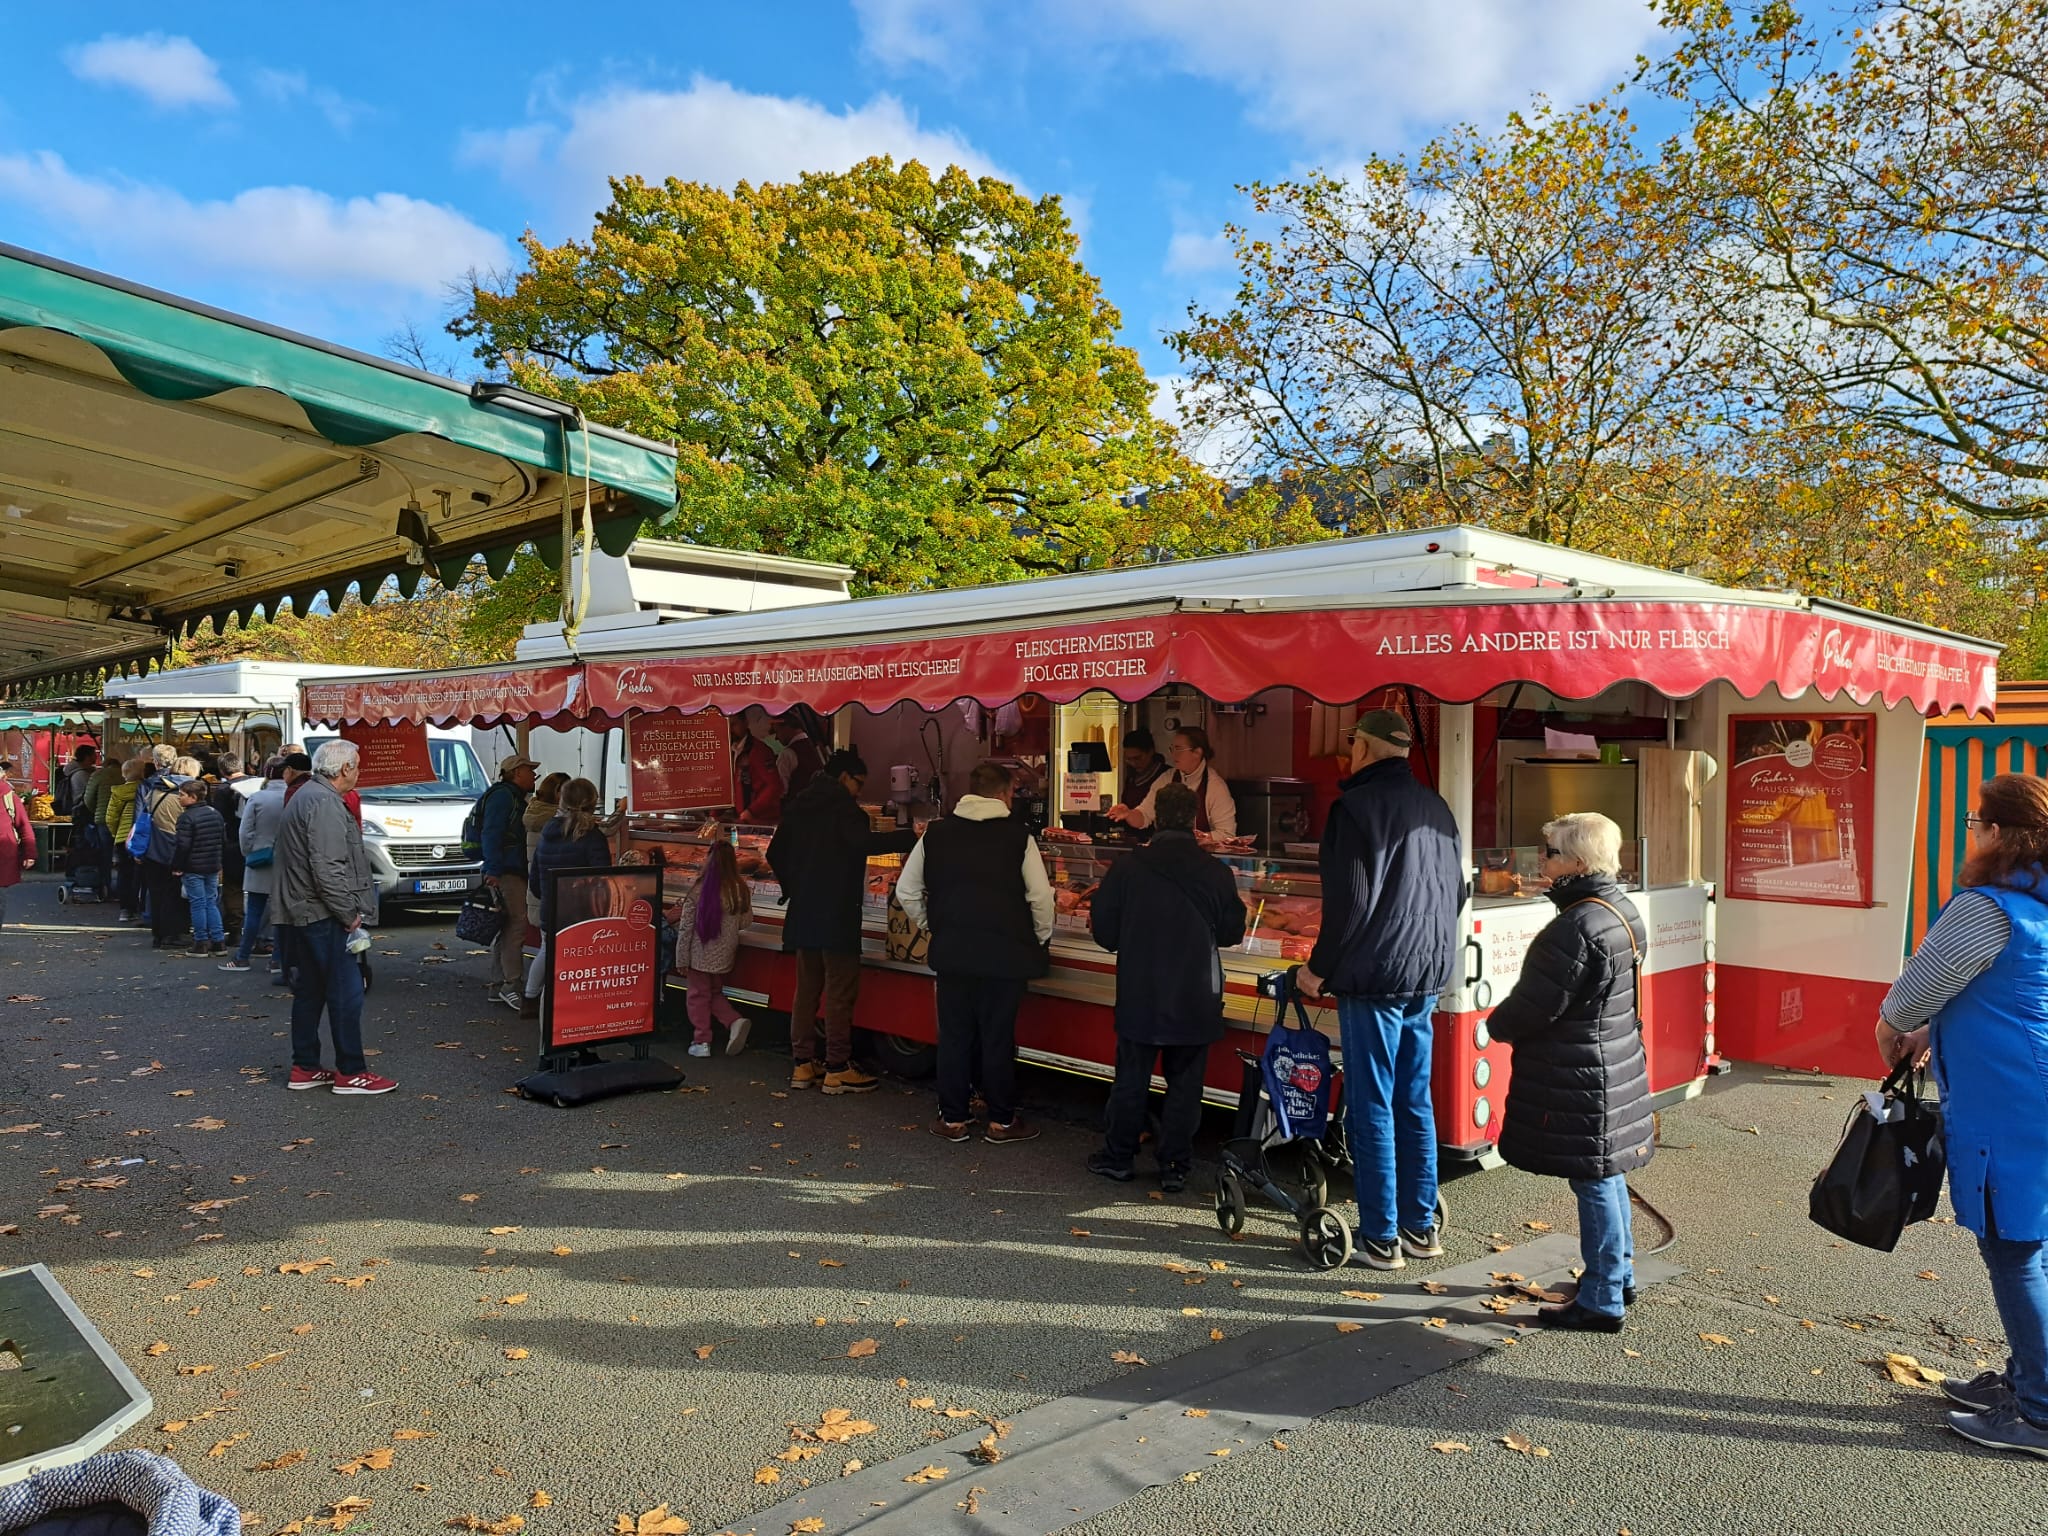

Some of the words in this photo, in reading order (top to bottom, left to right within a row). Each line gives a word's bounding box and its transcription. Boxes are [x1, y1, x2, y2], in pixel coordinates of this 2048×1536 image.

[1015, 630, 1155, 659] FLEISCHERMEISTER
[1375, 633, 1453, 655] ALLES
[1460, 631, 1561, 653] ANDERE
[1568, 630, 1600, 650] IST
[1607, 630, 1652, 650] NUR
[1659, 629, 1730, 651] FLEISCH
[692, 673, 712, 687] NUR
[713, 672, 732, 687] DAS
[734, 671, 761, 686] BESTE
[764, 670, 784, 685] AUS
[785, 669, 804, 683] DER
[807, 664, 884, 682] HAUSEIGENEN
[887, 658, 961, 679] FLEISCHEREI
[1023, 663, 1079, 683] HOLGER
[1083, 658, 1147, 679] FISCHER
[615, 666, 654, 701] Fischer
[643, 730, 717, 741] KESSELFRISCHE,
[640, 741, 721, 752] HAUSGEMACHTE
[650, 751, 716, 762] GRÜTZWURST
[1756, 785, 1842, 796] HAUSGEMACHTES
[436, 881, 446, 890] JR
[447, 880, 466, 889] 1001
[559, 967, 598, 981] GROBE
[600, 963, 650, 977] STREICH-
[569, 975, 639, 993] METTWURST
